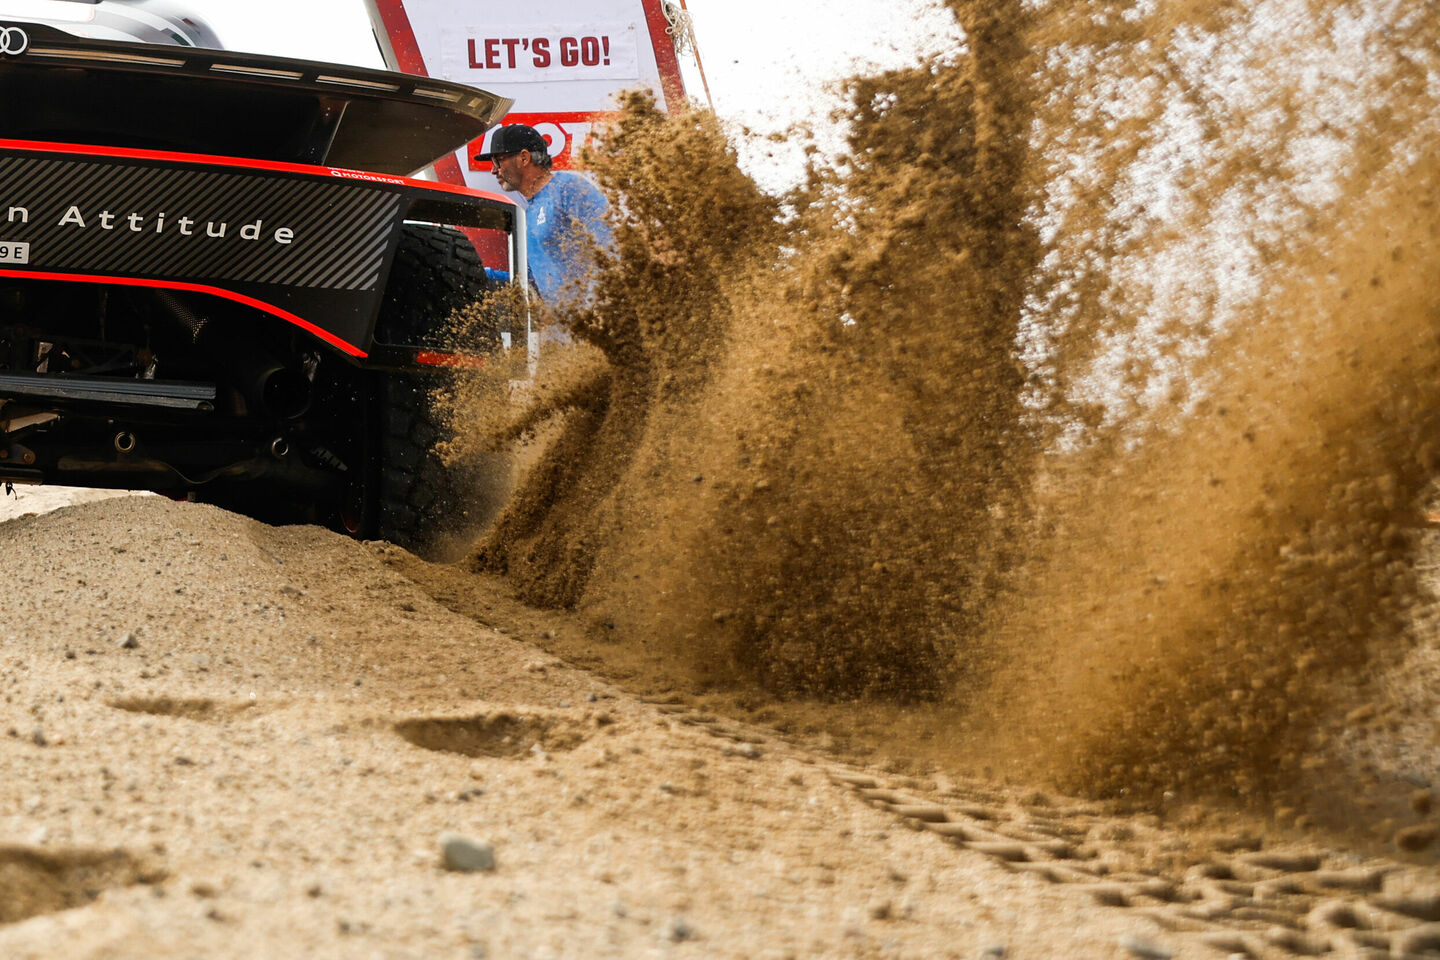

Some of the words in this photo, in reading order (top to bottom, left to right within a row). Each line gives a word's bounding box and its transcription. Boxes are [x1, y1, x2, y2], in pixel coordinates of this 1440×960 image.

[467, 37, 551, 69] LET'S
[559, 35, 610, 68] GO!
[58, 206, 295, 244] Attitude
[14, 247, 23, 259] E
